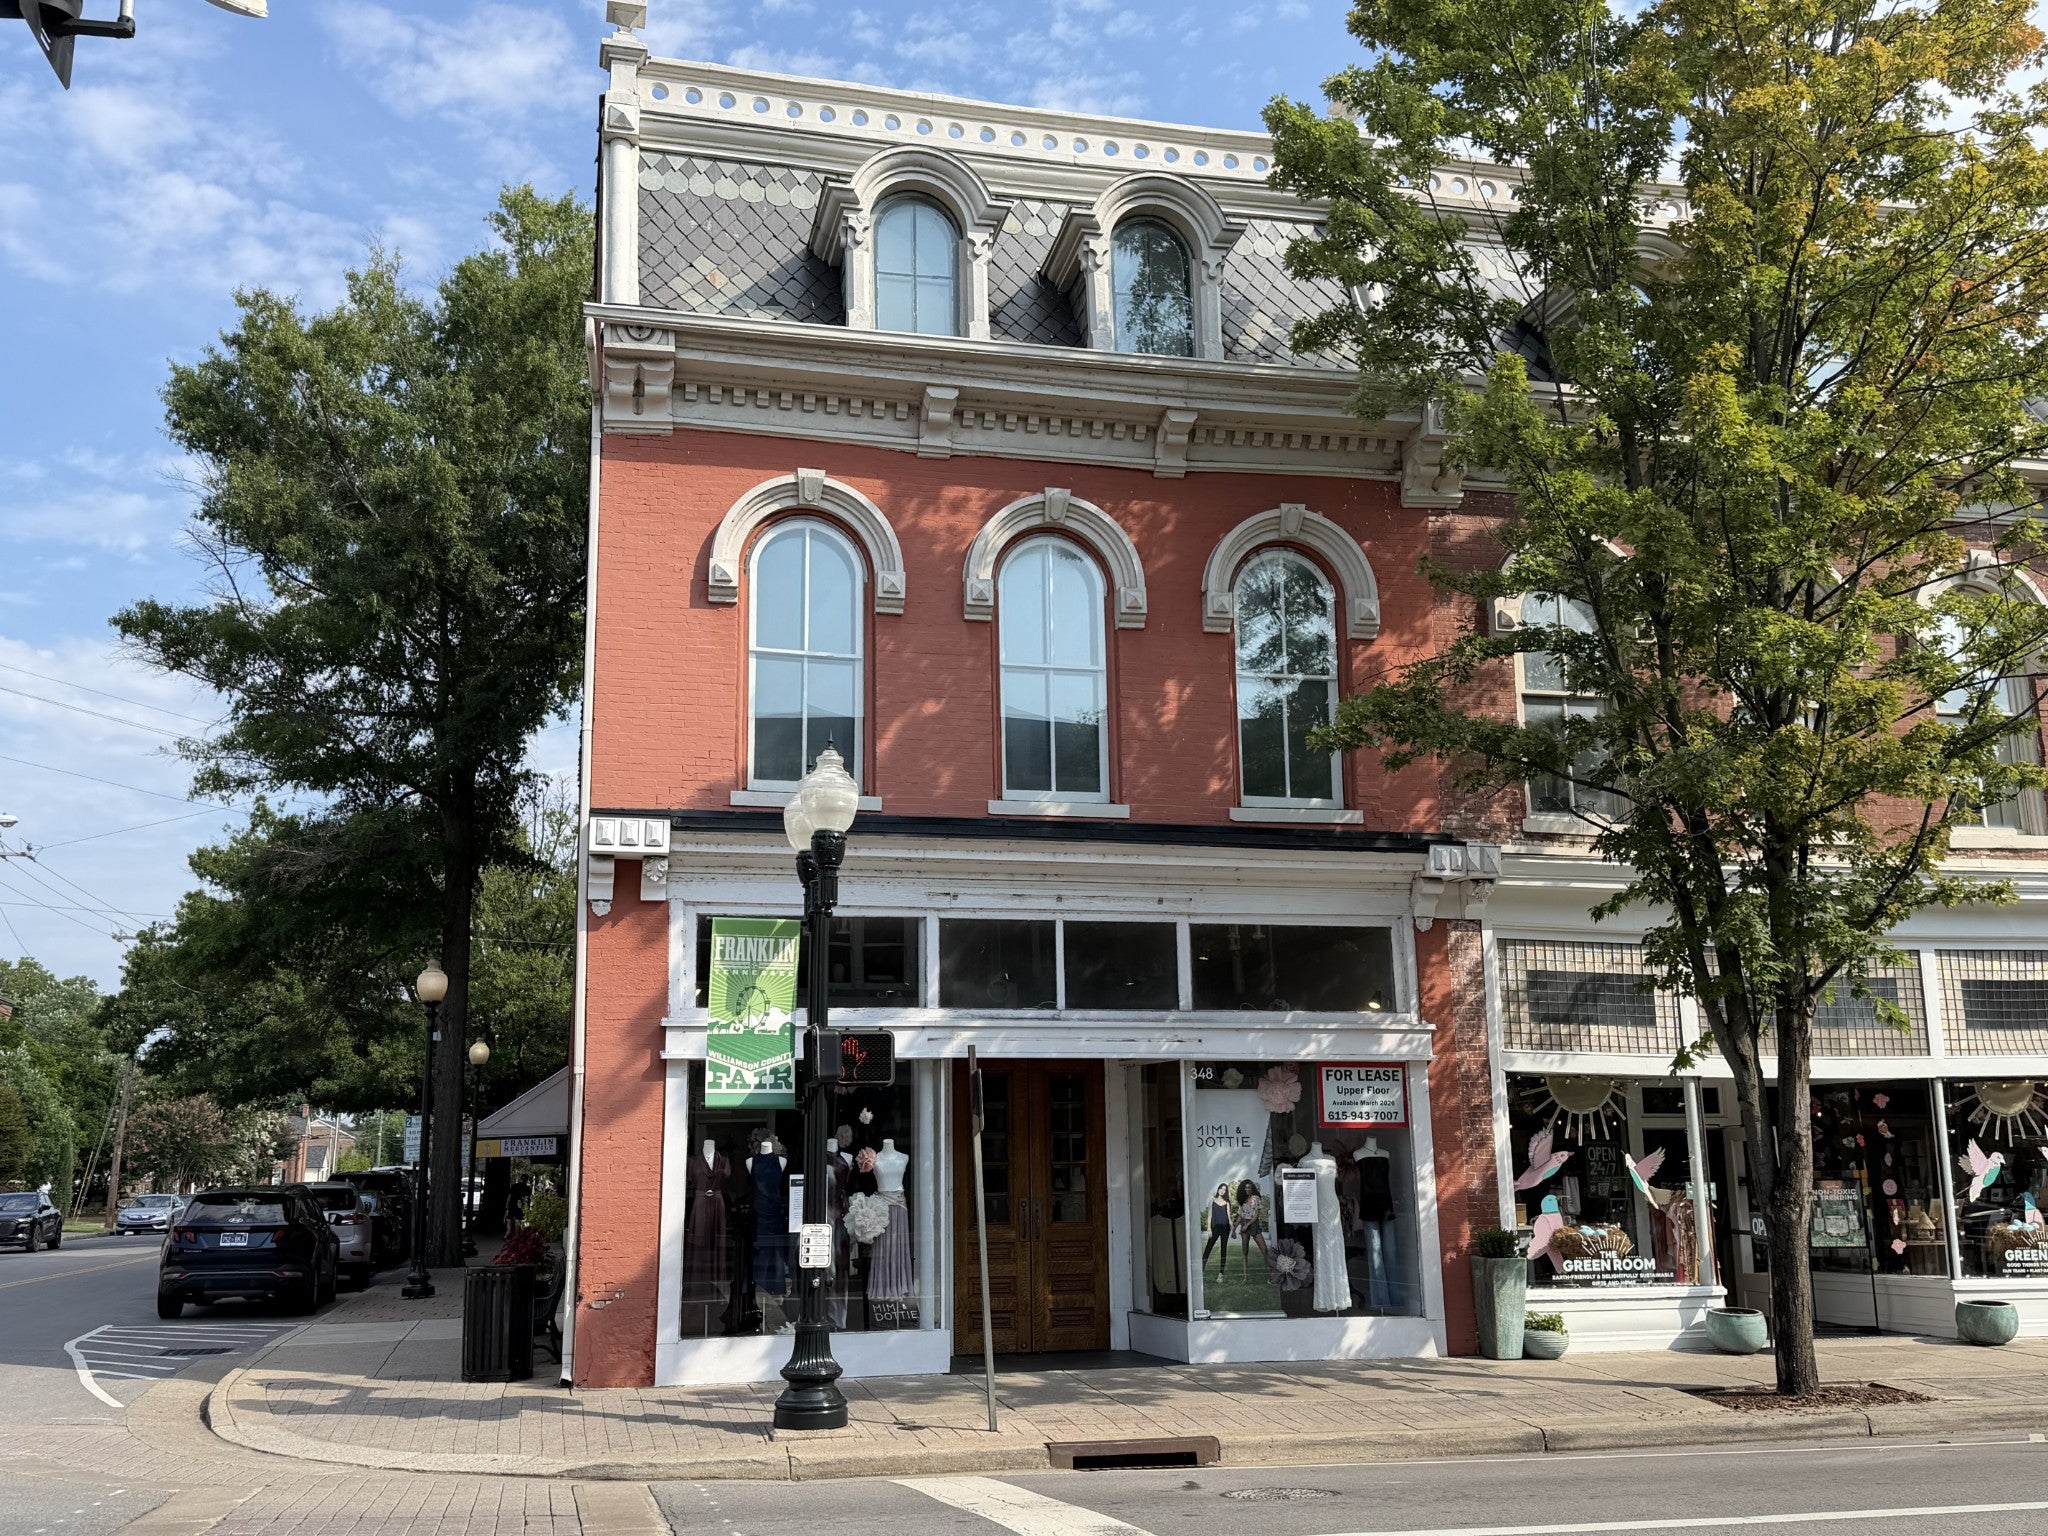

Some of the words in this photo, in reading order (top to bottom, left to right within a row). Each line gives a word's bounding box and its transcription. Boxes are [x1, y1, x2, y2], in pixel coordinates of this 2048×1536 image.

[715, 936, 796, 963] FRANKLIN
[714, 969, 795, 977] TENNESSEE
[708, 1050, 759, 1071] WILLIAMSON
[760, 1051, 793, 1067] COUNTY
[707, 1060, 793, 1090] FAIR
[1190, 1067, 1213, 1080] 348
[1325, 1069, 1353, 1081] FOR
[1357, 1069, 1400, 1081] LEASE
[1336, 1086, 1364, 1096] Upper
[1366, 1086, 1390, 1094] Floor
[1328, 1111, 1399, 1120] 615-943-7007
[406, 1118, 411, 1127] 2
[1235, 1126, 1241, 1134] &
[1587, 1146, 1616, 1161] OPEN
[1589, 1161, 1616, 1177] 24/7
[1812, 1188, 1857, 1196] NON-TOXIC
[1599, 1250, 1618, 1259] THE
[2004, 1249, 2048, 1261] GREEN
[1562, 1259, 1612, 1272] GREEN
[1613, 1258, 1656, 1271] ROOM
[874, 1310, 920, 1322] DOTTIE
